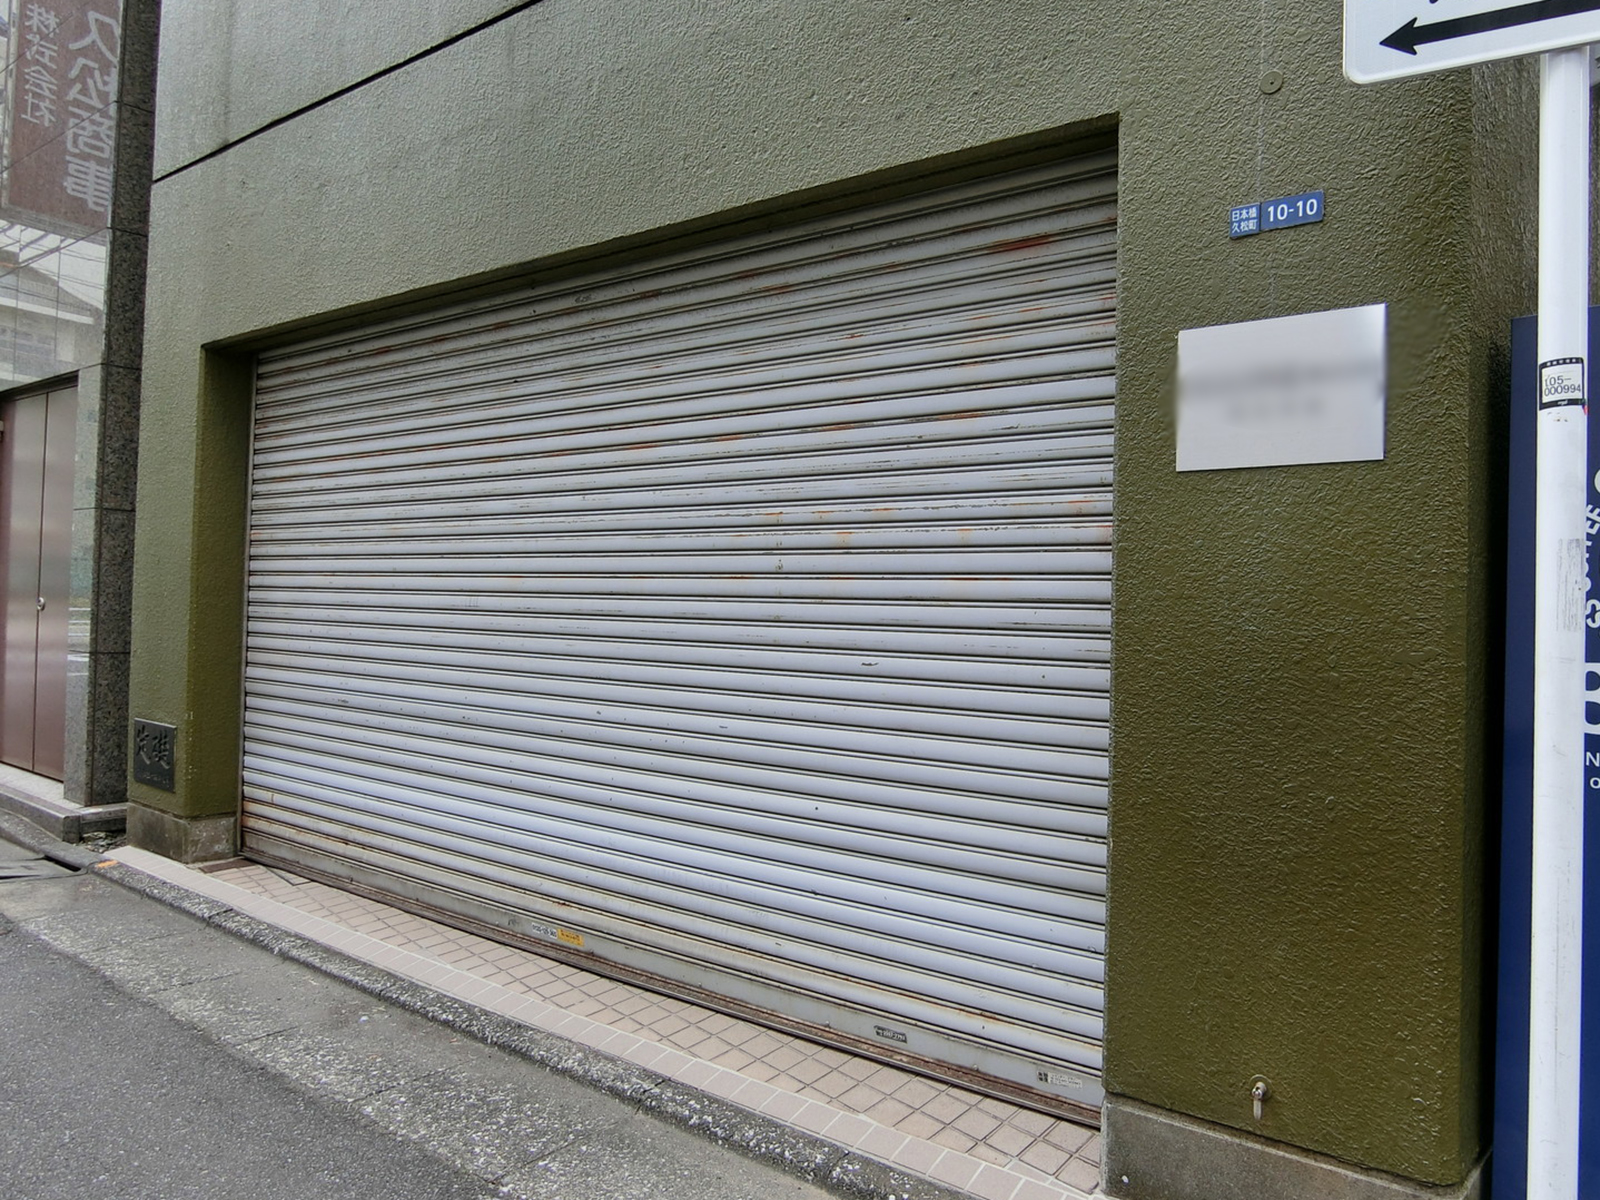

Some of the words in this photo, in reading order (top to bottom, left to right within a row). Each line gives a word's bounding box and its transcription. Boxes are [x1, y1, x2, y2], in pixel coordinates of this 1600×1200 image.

[1231, 207, 1257, 221] 日本橋
[1267, 198, 1318, 222] 10-10
[1231, 219, 1257, 233] 久松町
[1543, 384, 1581, 397] 000994
